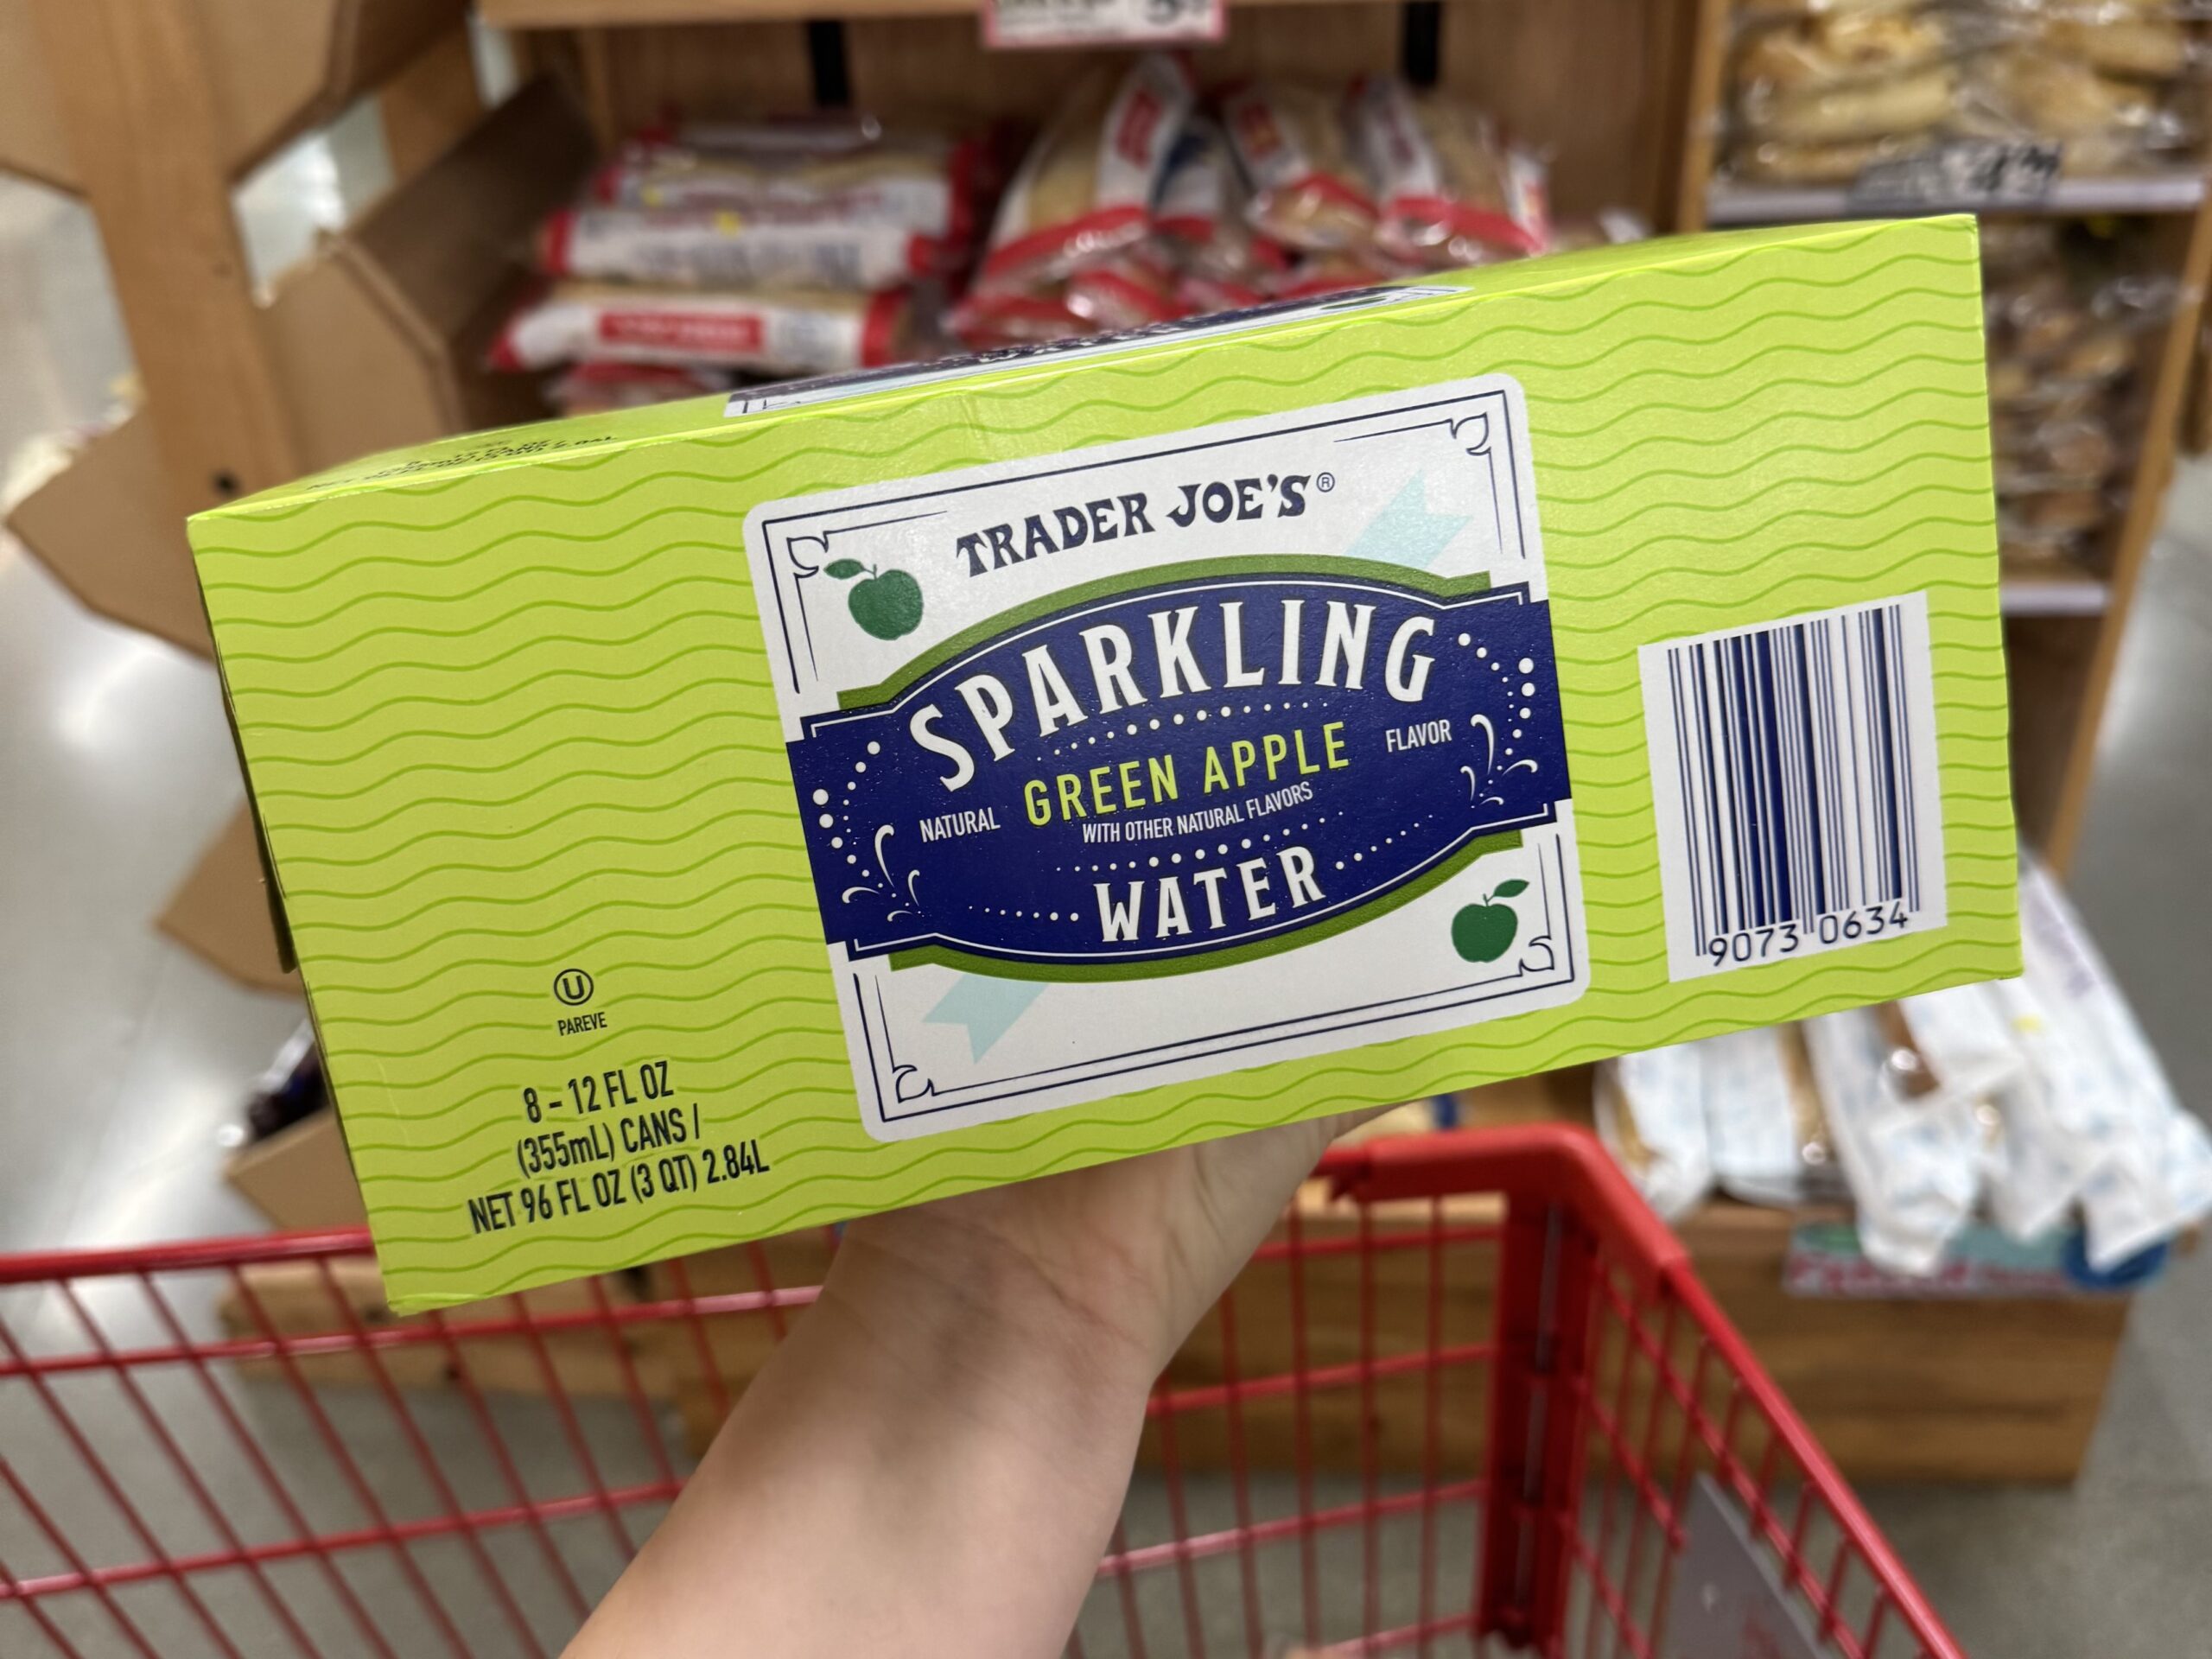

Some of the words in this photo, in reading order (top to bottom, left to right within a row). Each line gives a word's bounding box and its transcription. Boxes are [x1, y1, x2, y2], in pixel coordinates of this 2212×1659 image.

[956, 492, 1156, 578] TRADER
[909, 599, 1436, 792] SPARKLING
[1385, 719, 1452, 753] FLAVOR
[1023, 754, 1179, 827] GREEN
[1204, 721, 1351, 794] APPLE
[918, 806, 1001, 843] NATURAL
[1082, 822, 1121, 844] WITH
[1125, 817, 1174, 842] OTHER
[1177, 804, 1246, 836] NATURAL
[1246, 780, 1314, 820] FLAVORS
[1092, 845, 1327, 944] WATER
[1707, 923, 1800, 967] 9073
[1819, 899, 1909, 945] 0634
[557, 1012, 607, 1036] PAREVE
[522, 1086, 543, 1123] 8
[567, 1075, 602, 1115] 12
[602, 1068, 638, 1109] FL
[639, 1059, 675, 1100] OZ
[517, 1122, 615, 1180] (355mL)
[620, 1106, 687, 1154] CANS
[467, 1189, 517, 1235] NET
[520, 1185, 554, 1224] 96
[556, 1177, 591, 1216] FL
[591, 1168, 626, 1208] OZ
[630, 1161, 655, 1204] (3
[659, 1153, 698, 1193] QT)
[702, 1138, 771, 1185] 2.84L
